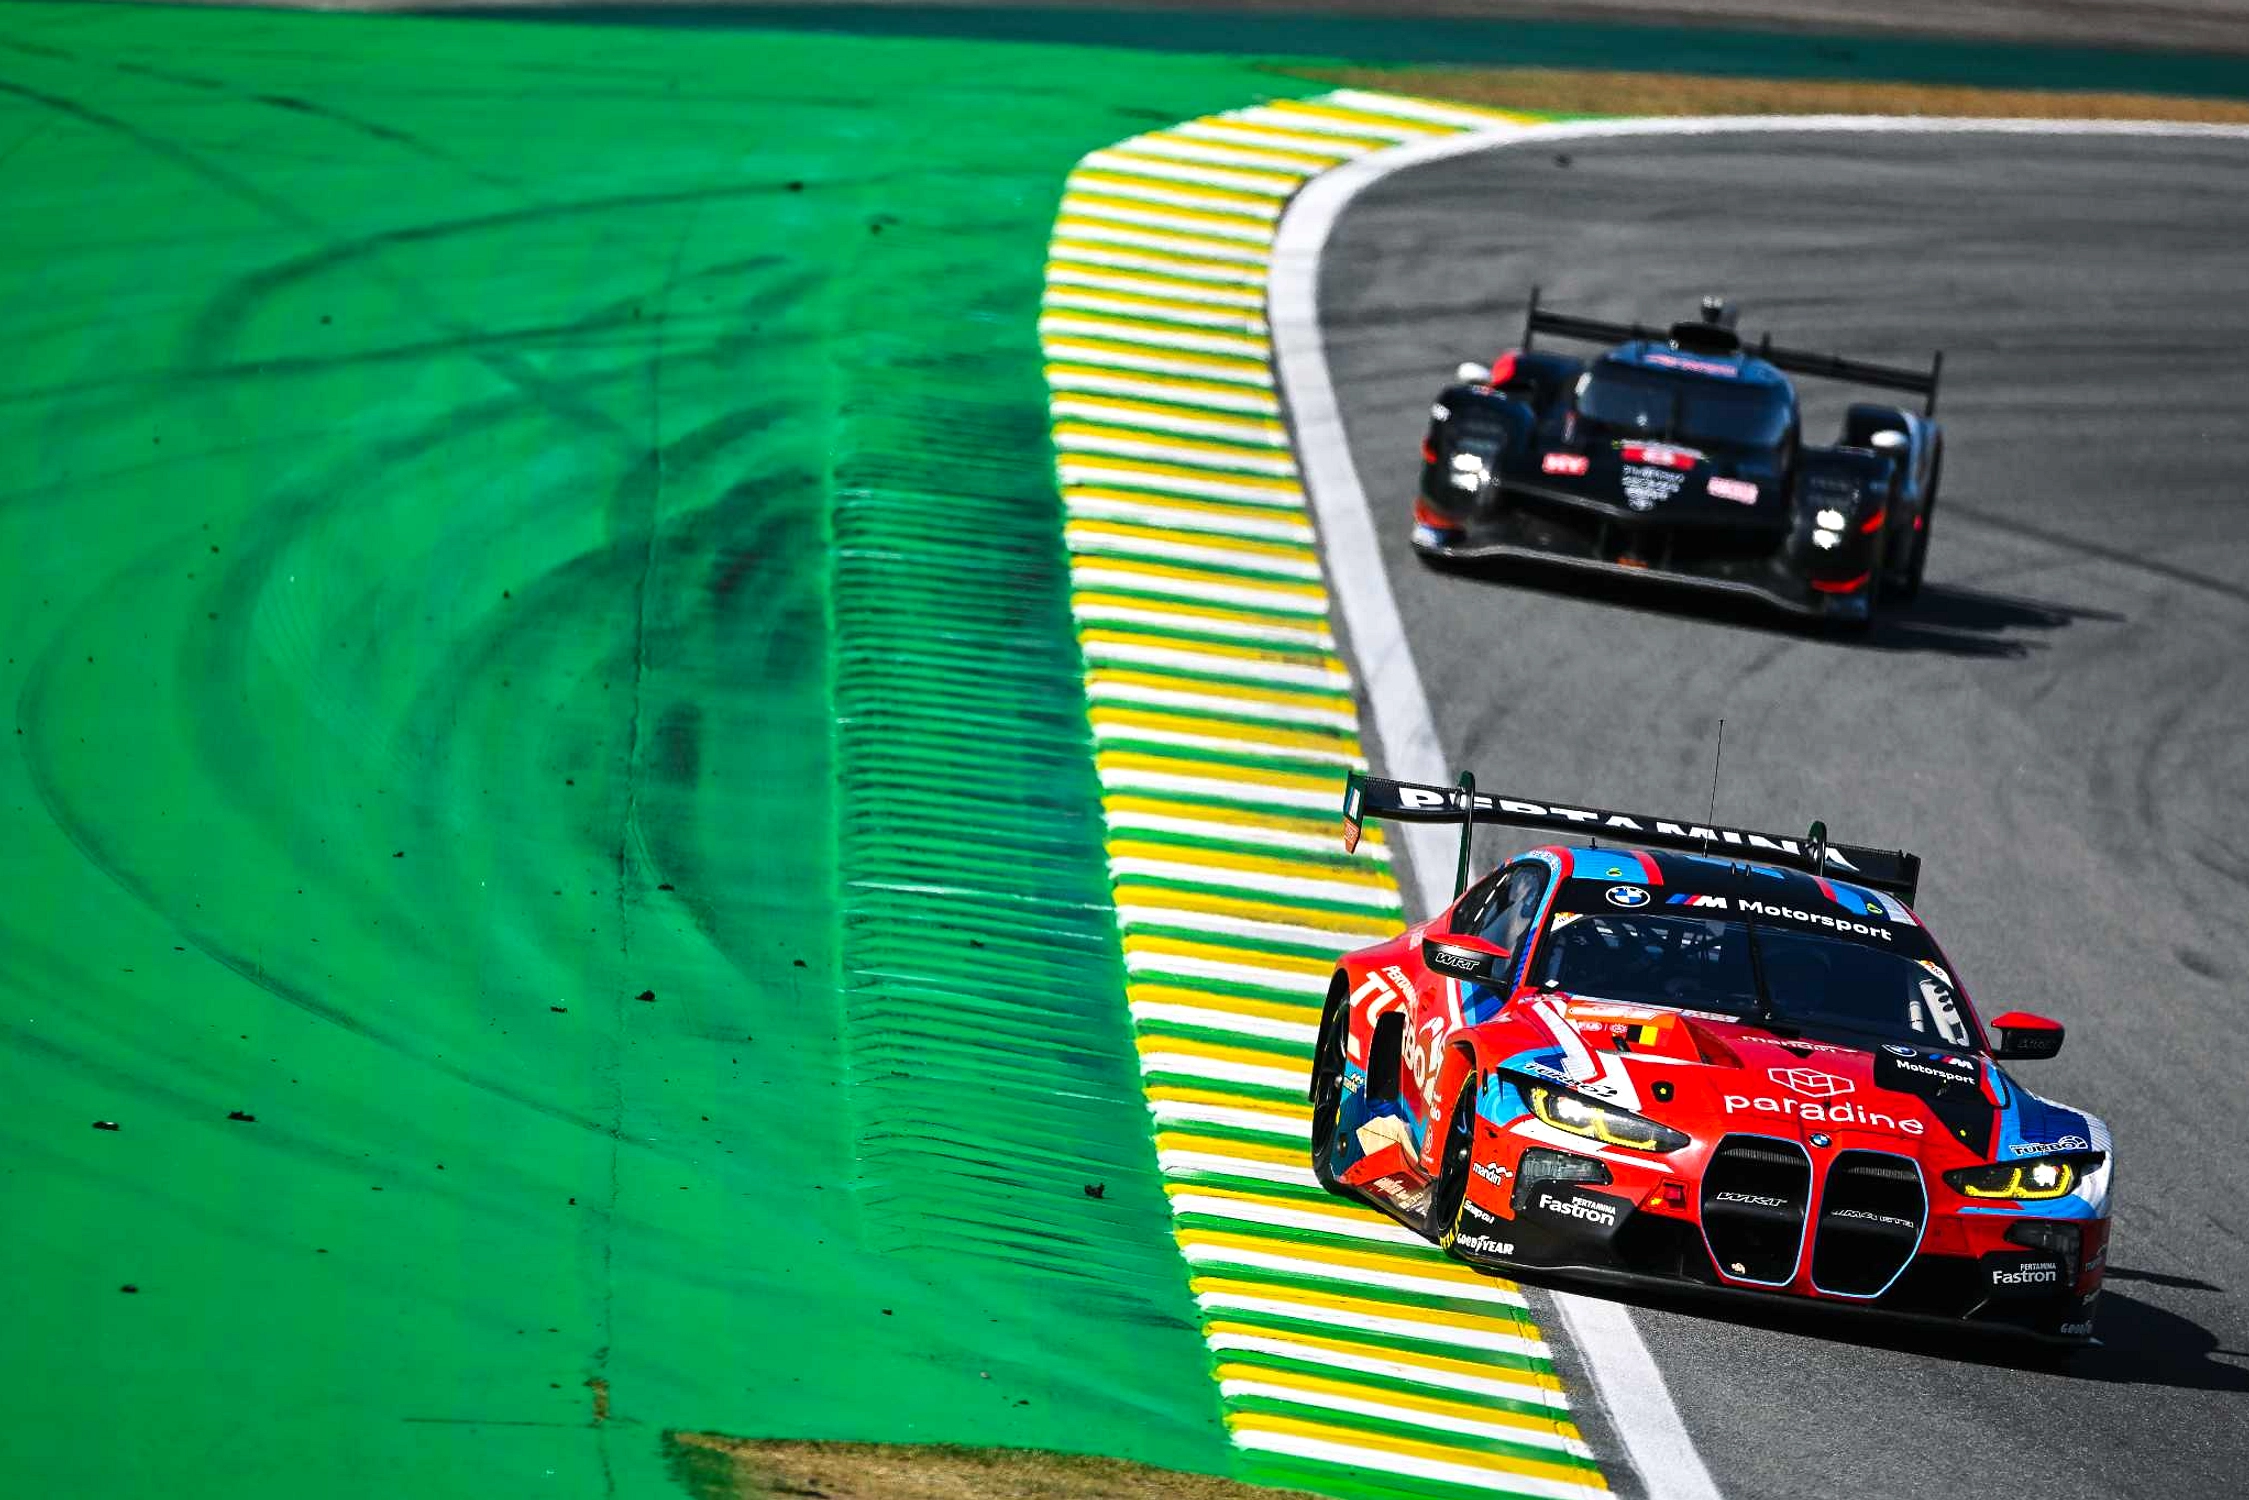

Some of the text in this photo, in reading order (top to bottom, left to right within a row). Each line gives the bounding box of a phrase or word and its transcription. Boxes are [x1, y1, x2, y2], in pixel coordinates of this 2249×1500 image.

[1738, 898, 1892, 942] Motorsport
[1435, 951, 1480, 971] WRT
[1896, 1059, 1975, 1085] Motorsport
[1724, 1095, 1924, 1135] paradine
[1539, 1193, 1615, 1226] Fastron
[1992, 1269, 2057, 1285] Fastron
